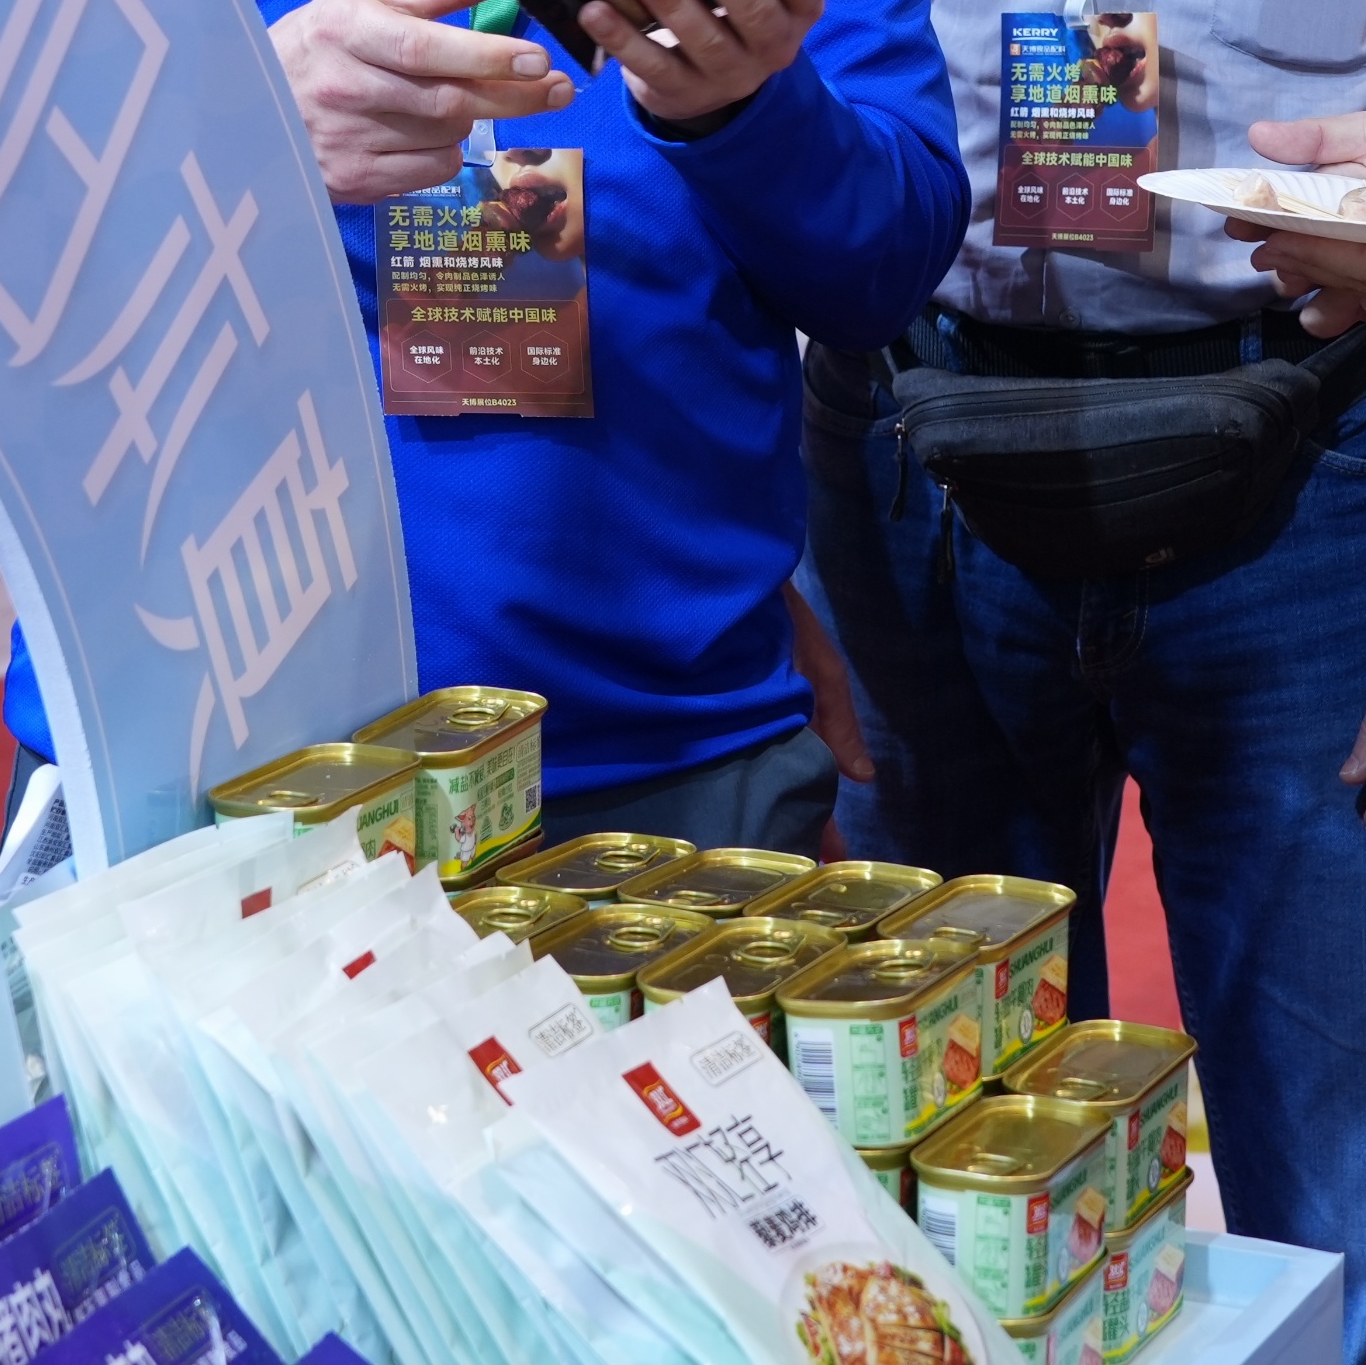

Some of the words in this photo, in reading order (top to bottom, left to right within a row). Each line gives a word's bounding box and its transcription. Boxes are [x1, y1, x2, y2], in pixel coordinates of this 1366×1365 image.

[1013, 28, 1058, 36] KERRY
[1010, 63, 1081, 82] 无需火烤
[1010, 86, 1117, 104] 享地道烟熏味
[1021, 151, 1133, 168] 全球技术赋能中国味
[389, 205, 482, 227] 无需火烤
[389, 230, 531, 252] 享地道烟熏味
[390, 256, 415, 268] 红箭
[419, 257, 503, 269] 烟熏和烧烤风味
[411, 307, 557, 323] 全球技术赋能中国味
[410, 346, 444, 355] 全球风味
[469, 346, 503, 355] 前沿技术
[527, 347, 561, 356] 国际标准
[414, 355, 440, 365] 在地化
[474, 357, 500, 365] 本土化
[532, 357, 557, 366] 身边化
[462, 398, 517, 407] 天博展位B4023
[699, 1036, 756, 1078] 清洁标签
